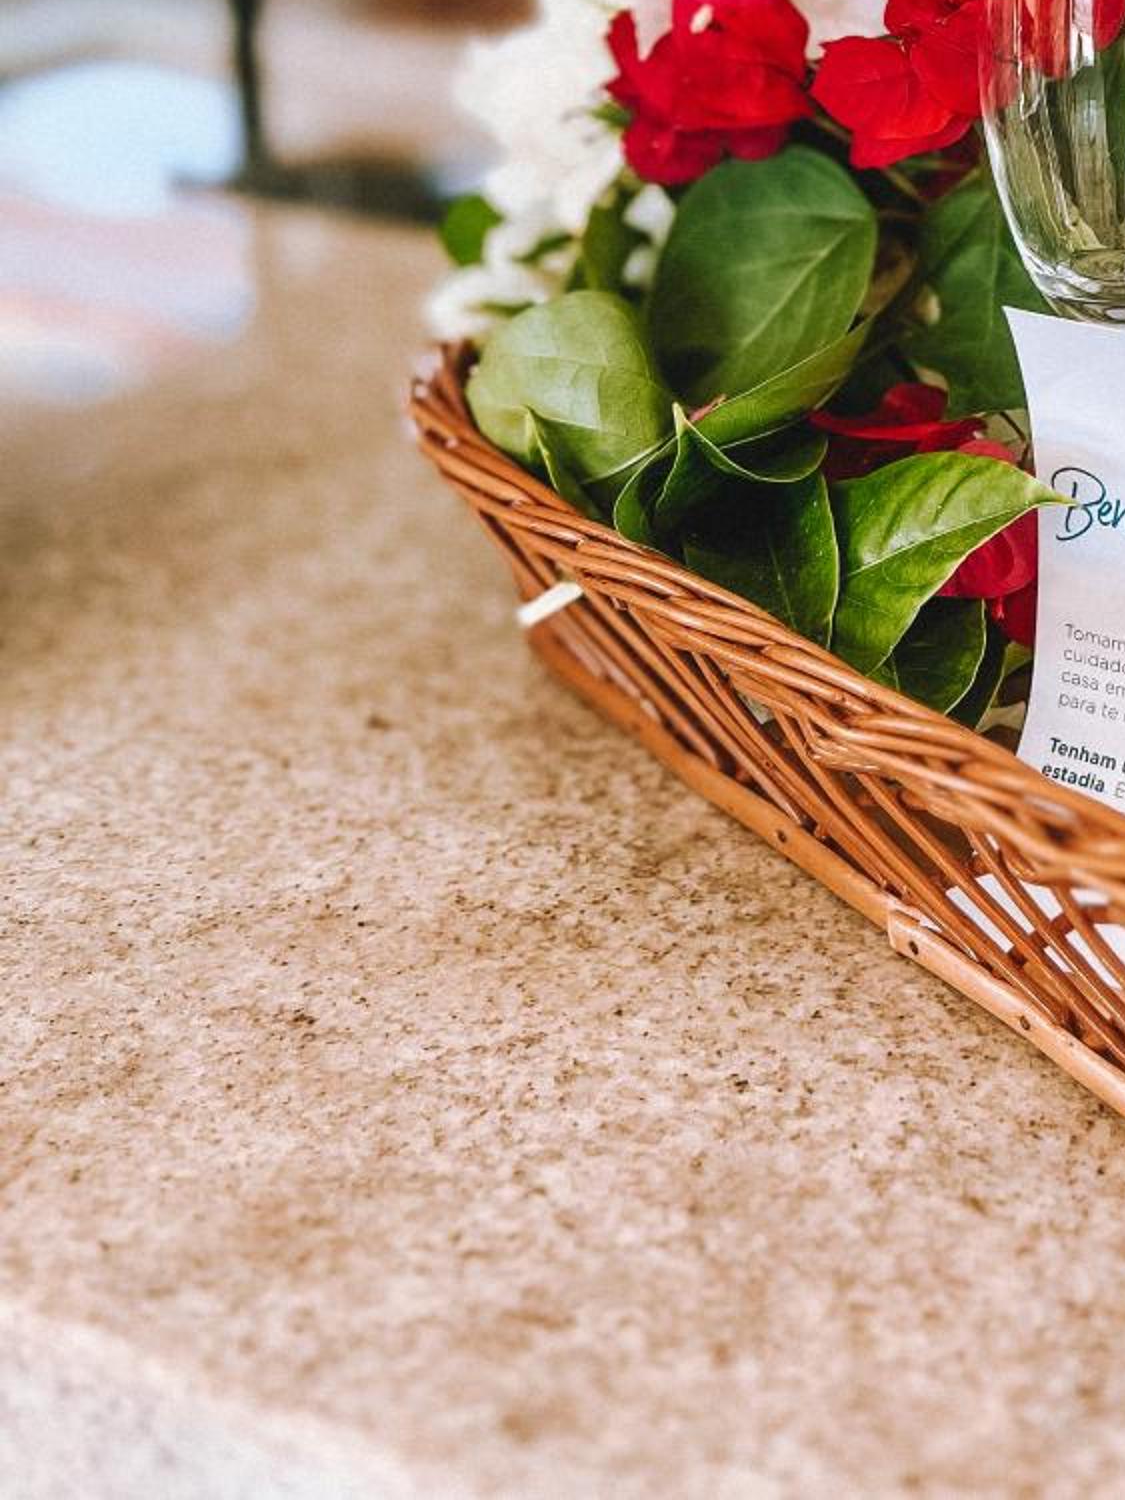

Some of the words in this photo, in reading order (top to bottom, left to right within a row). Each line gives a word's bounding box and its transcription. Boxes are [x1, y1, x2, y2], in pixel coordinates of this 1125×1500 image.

[1061, 669, 1100, 691] casa
[1057, 692, 1097, 715] para
[1101, 702, 1119, 721] te
[1050, 737, 1117, 771] Tenham
